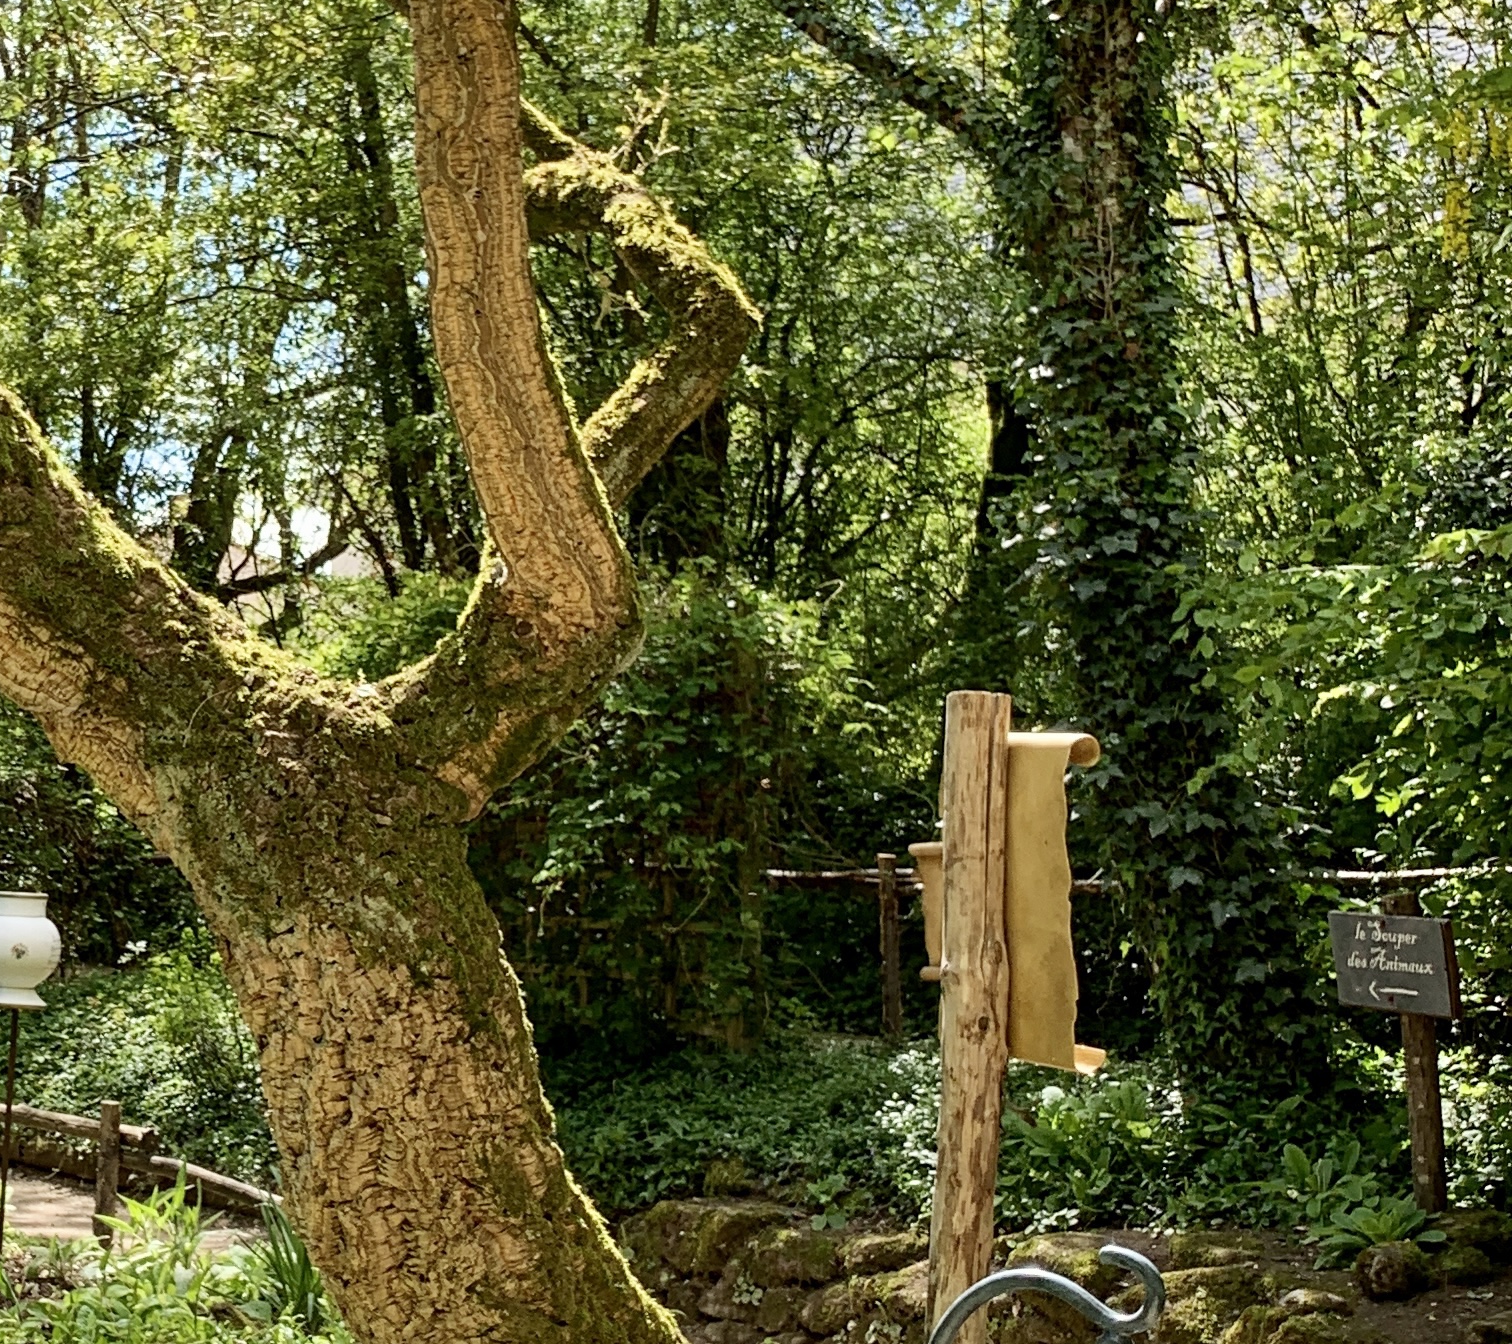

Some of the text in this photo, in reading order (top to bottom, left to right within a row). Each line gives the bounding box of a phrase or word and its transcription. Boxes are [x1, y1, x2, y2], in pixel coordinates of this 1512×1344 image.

[1354, 920, 1418, 950] le Souper
[1347, 946, 1434, 975] des Animaux
